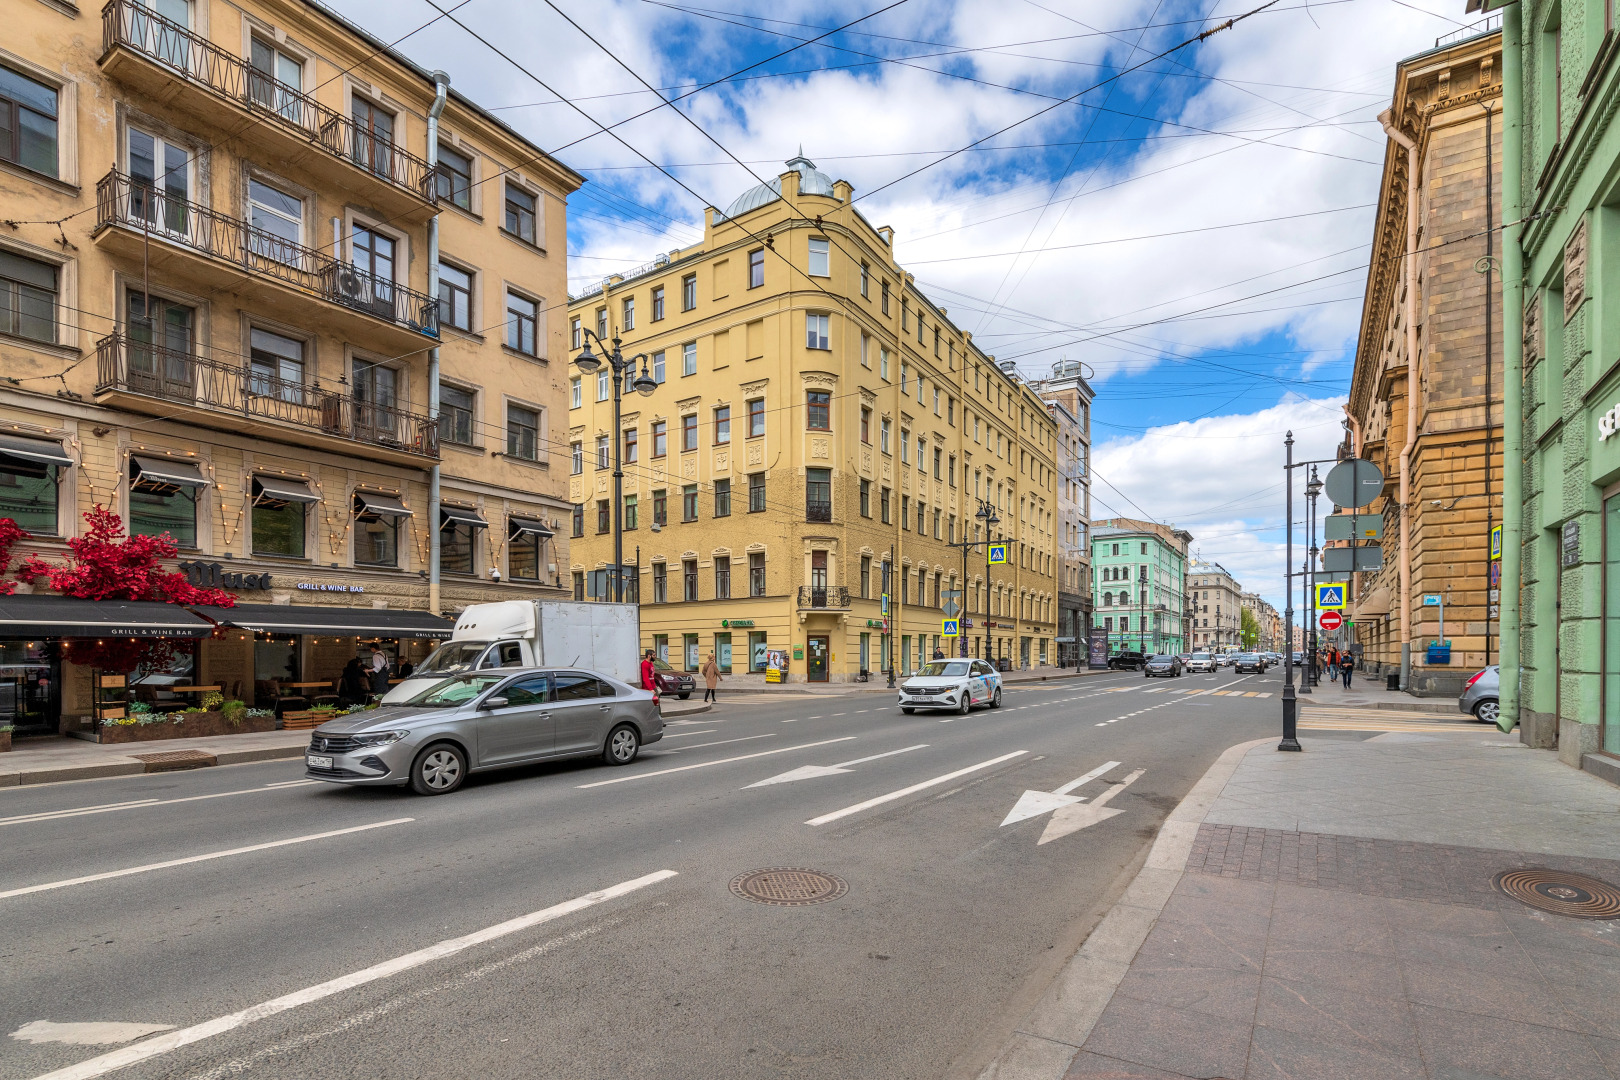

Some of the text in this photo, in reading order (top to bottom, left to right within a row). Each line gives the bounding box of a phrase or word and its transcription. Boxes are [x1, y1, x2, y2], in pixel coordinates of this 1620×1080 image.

[178, 561, 273, 590] Must
[297, 582, 364, 593] GRILL & WINE BAR
